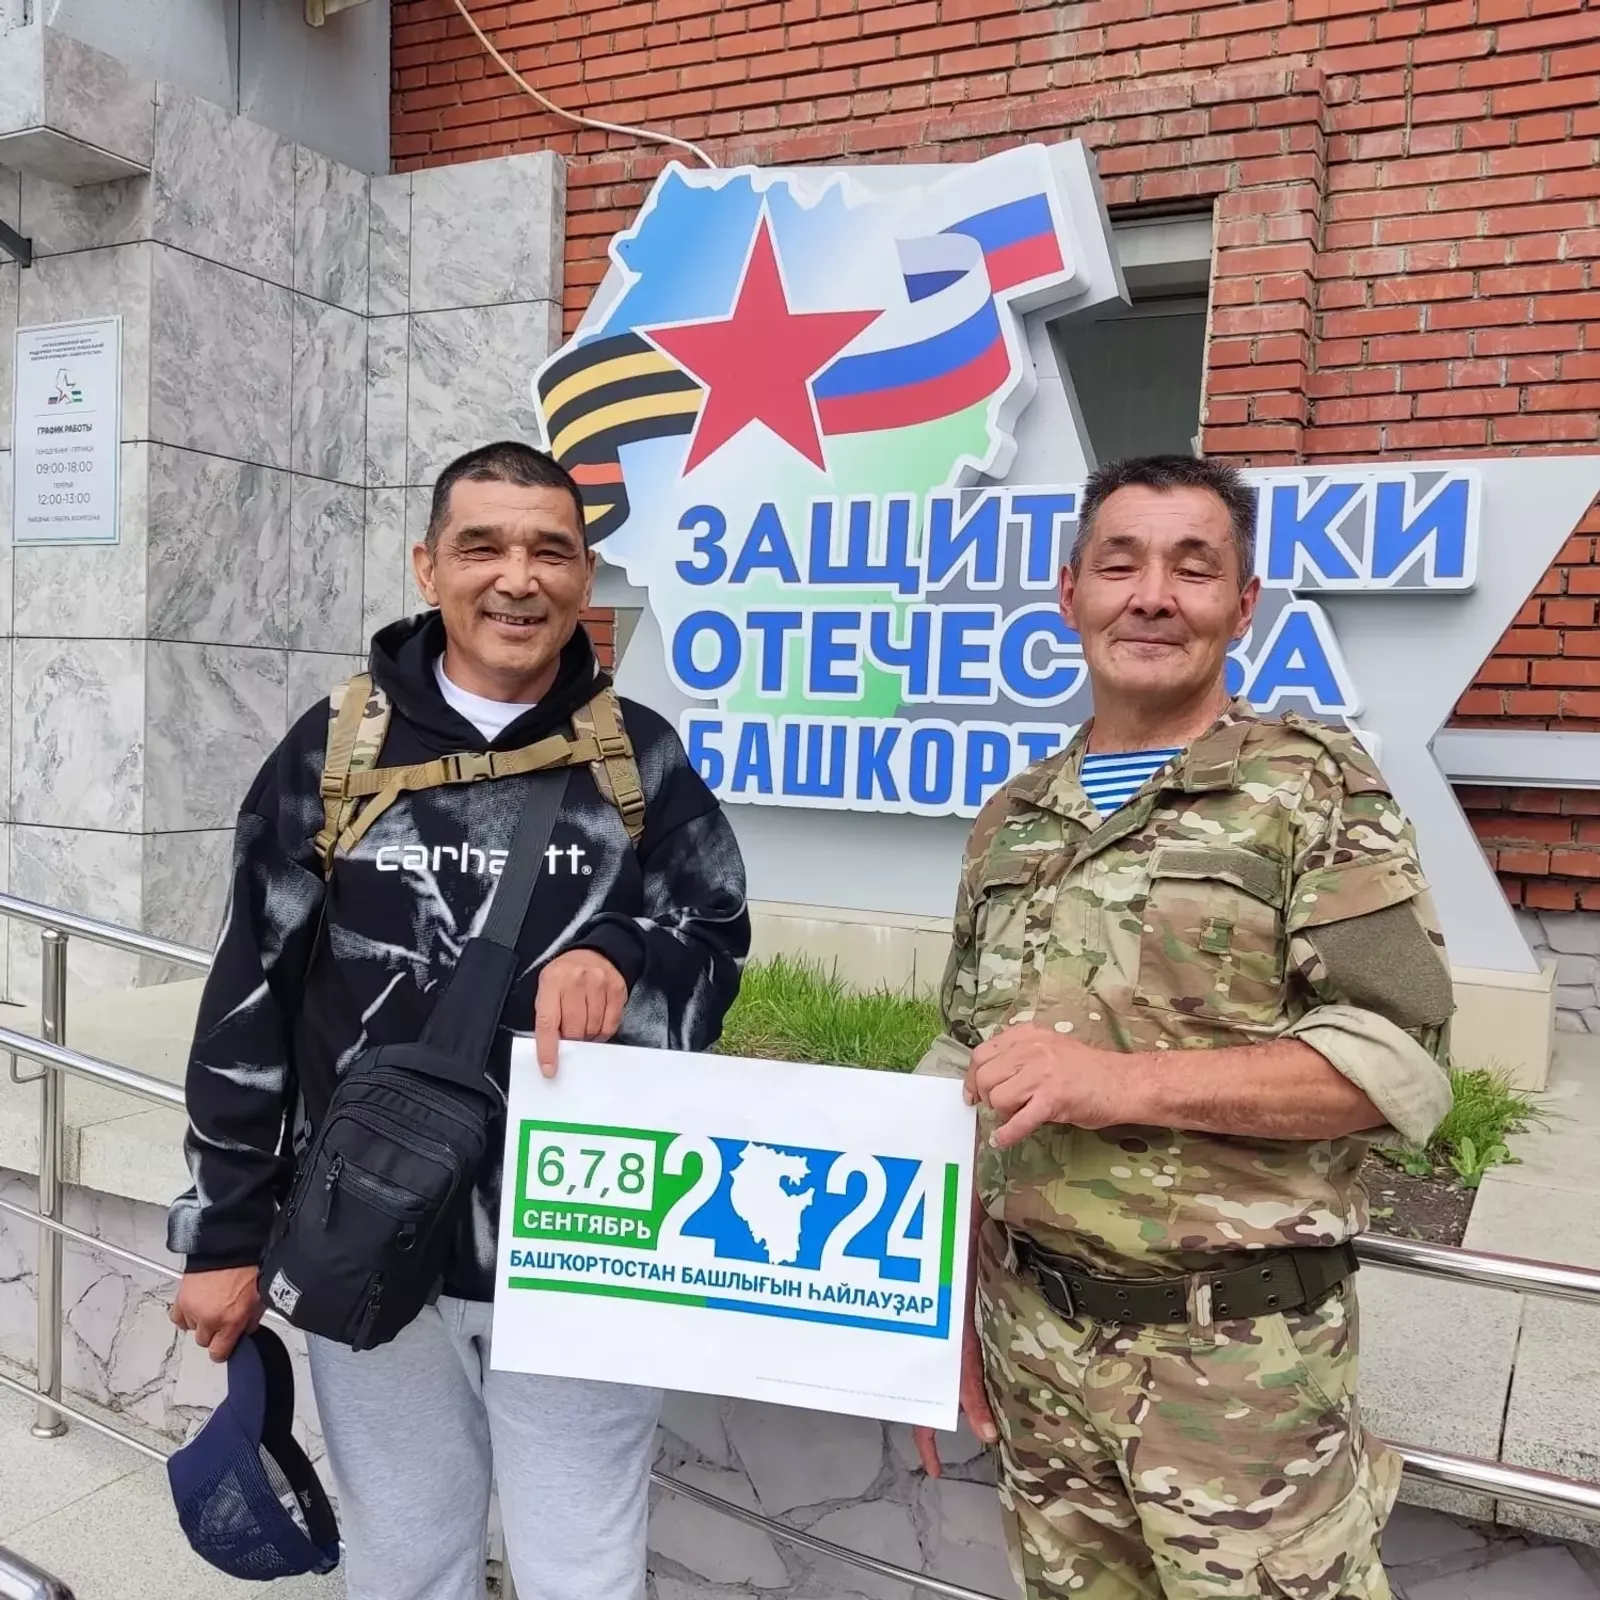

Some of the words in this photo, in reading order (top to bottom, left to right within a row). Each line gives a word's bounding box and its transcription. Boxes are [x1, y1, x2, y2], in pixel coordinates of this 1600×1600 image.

[37, 426, 64, 435] ГРАФИК
[65, 424, 93, 433] РАБОТЫ
[36, 461, 93, 474] 09:00-18:00
[38, 493, 91, 505] 12:00-13:00
[675, 480, 1470, 594] ЗАЩИТКИ
[537, 1145, 645, 1198] 6,7,8
[523, 1209, 652, 1240] СЕНТЯБРЬ
[681, 1266, 802, 1299] БАШЛЫҒЫН
